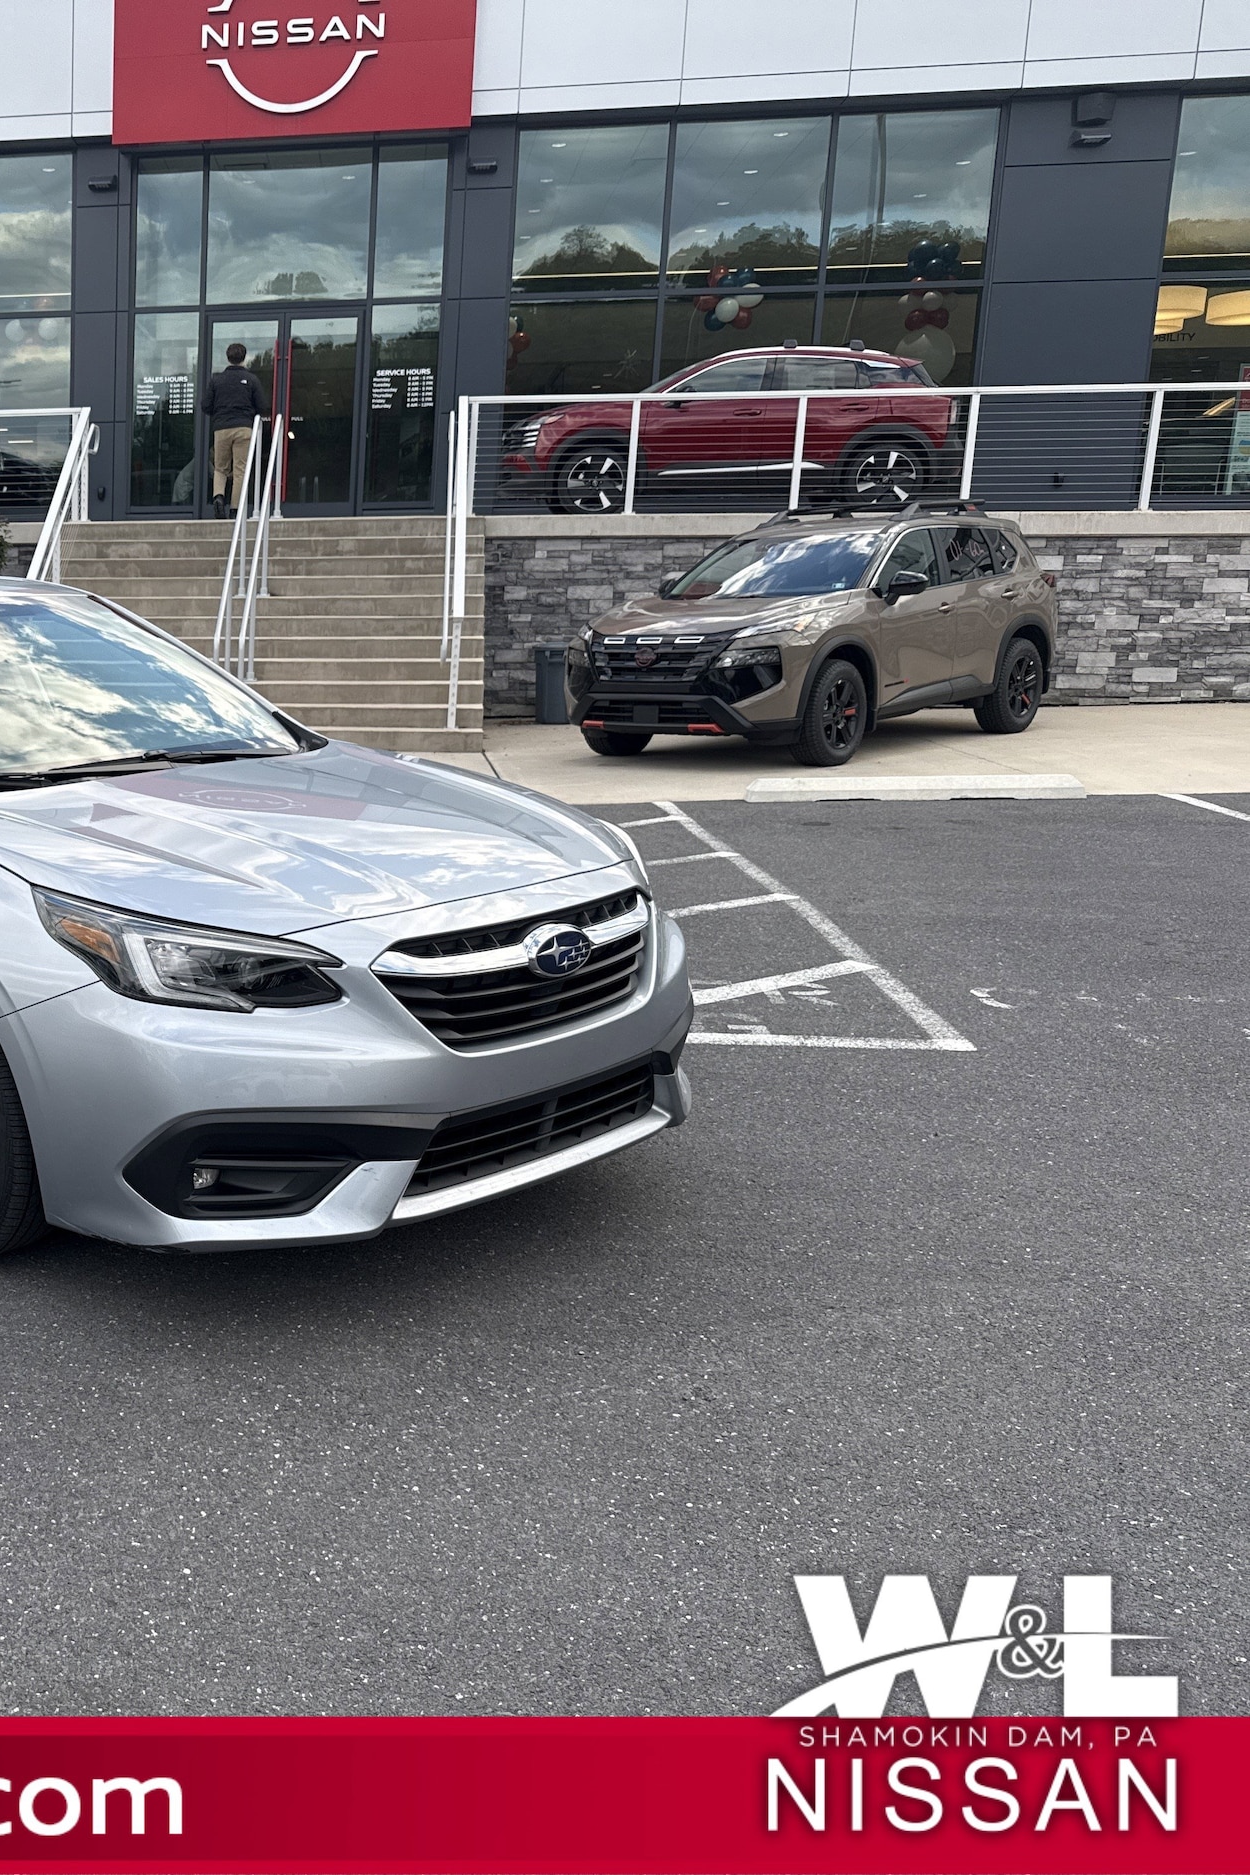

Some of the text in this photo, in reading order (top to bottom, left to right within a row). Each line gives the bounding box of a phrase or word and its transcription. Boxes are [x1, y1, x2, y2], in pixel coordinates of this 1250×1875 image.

[201, 12, 386, 49] NISSAN
[1153, 333, 1195, 342] BILITY
[376, 368, 431, 377] SERVICE HOURS
